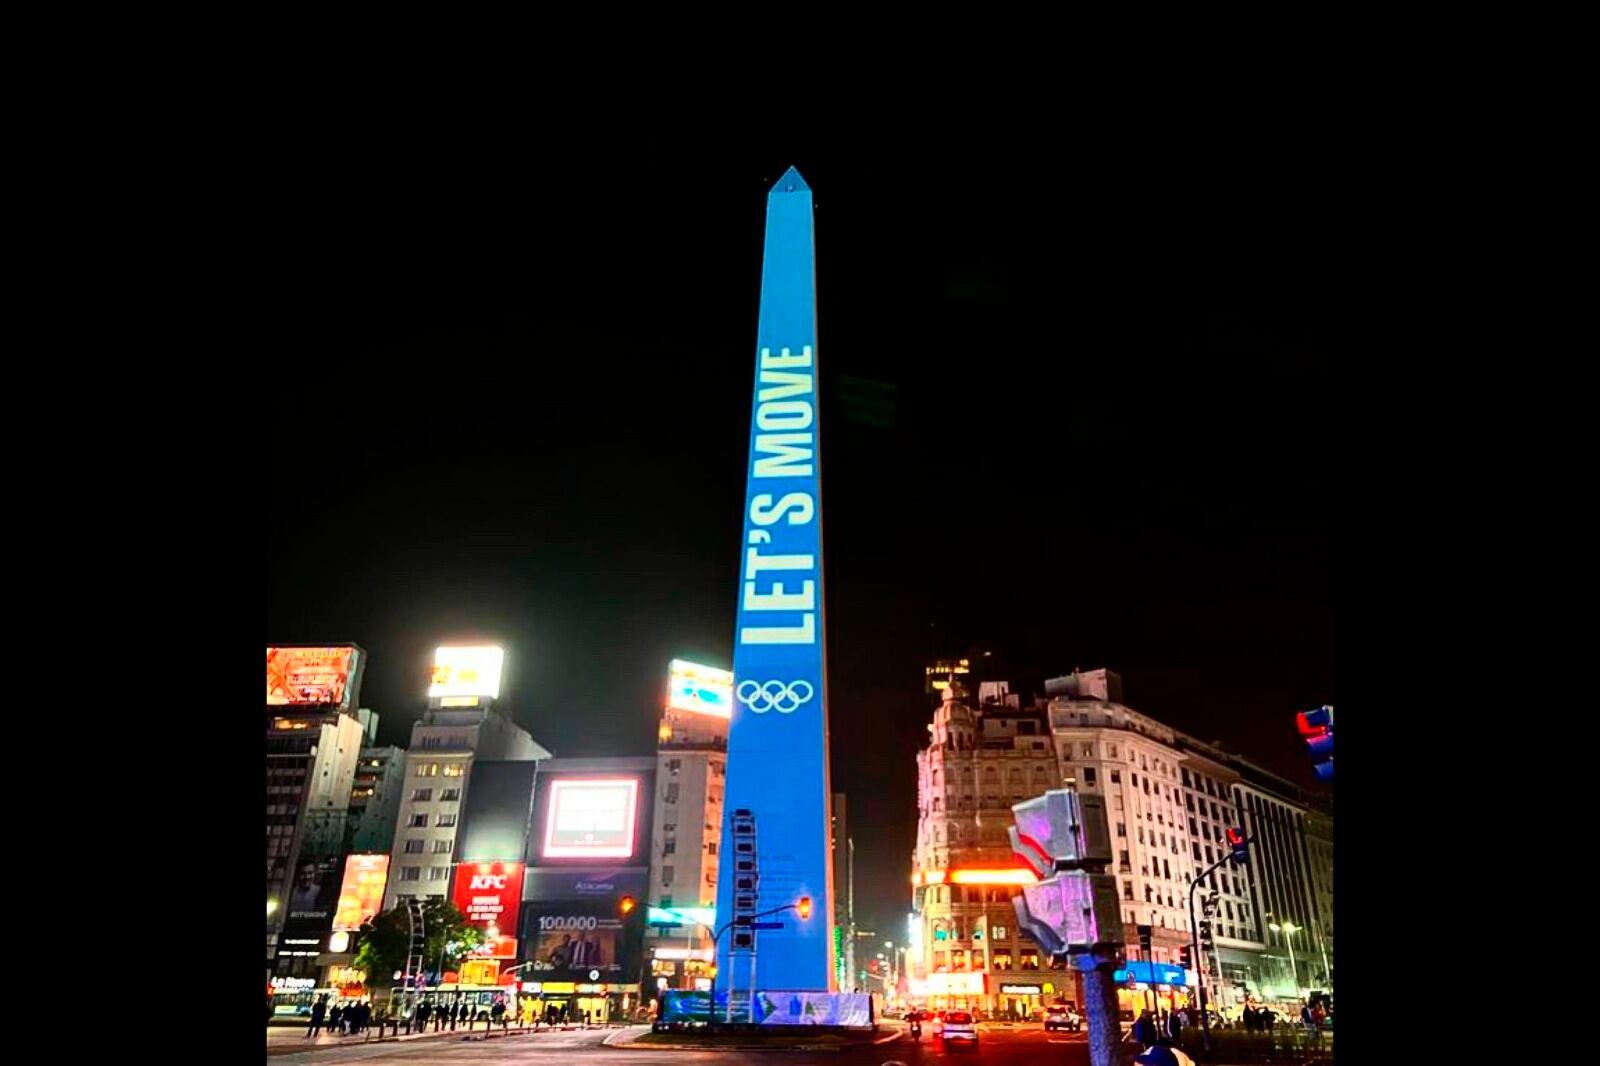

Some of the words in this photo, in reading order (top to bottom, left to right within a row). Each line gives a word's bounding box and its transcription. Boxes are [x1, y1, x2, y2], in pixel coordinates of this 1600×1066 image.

[753, 345, 814, 478] MOVE
[741, 493, 815, 645] LET'S
[469, 875, 508, 889] KFC
[538, 917, 597, 930] 100.000
